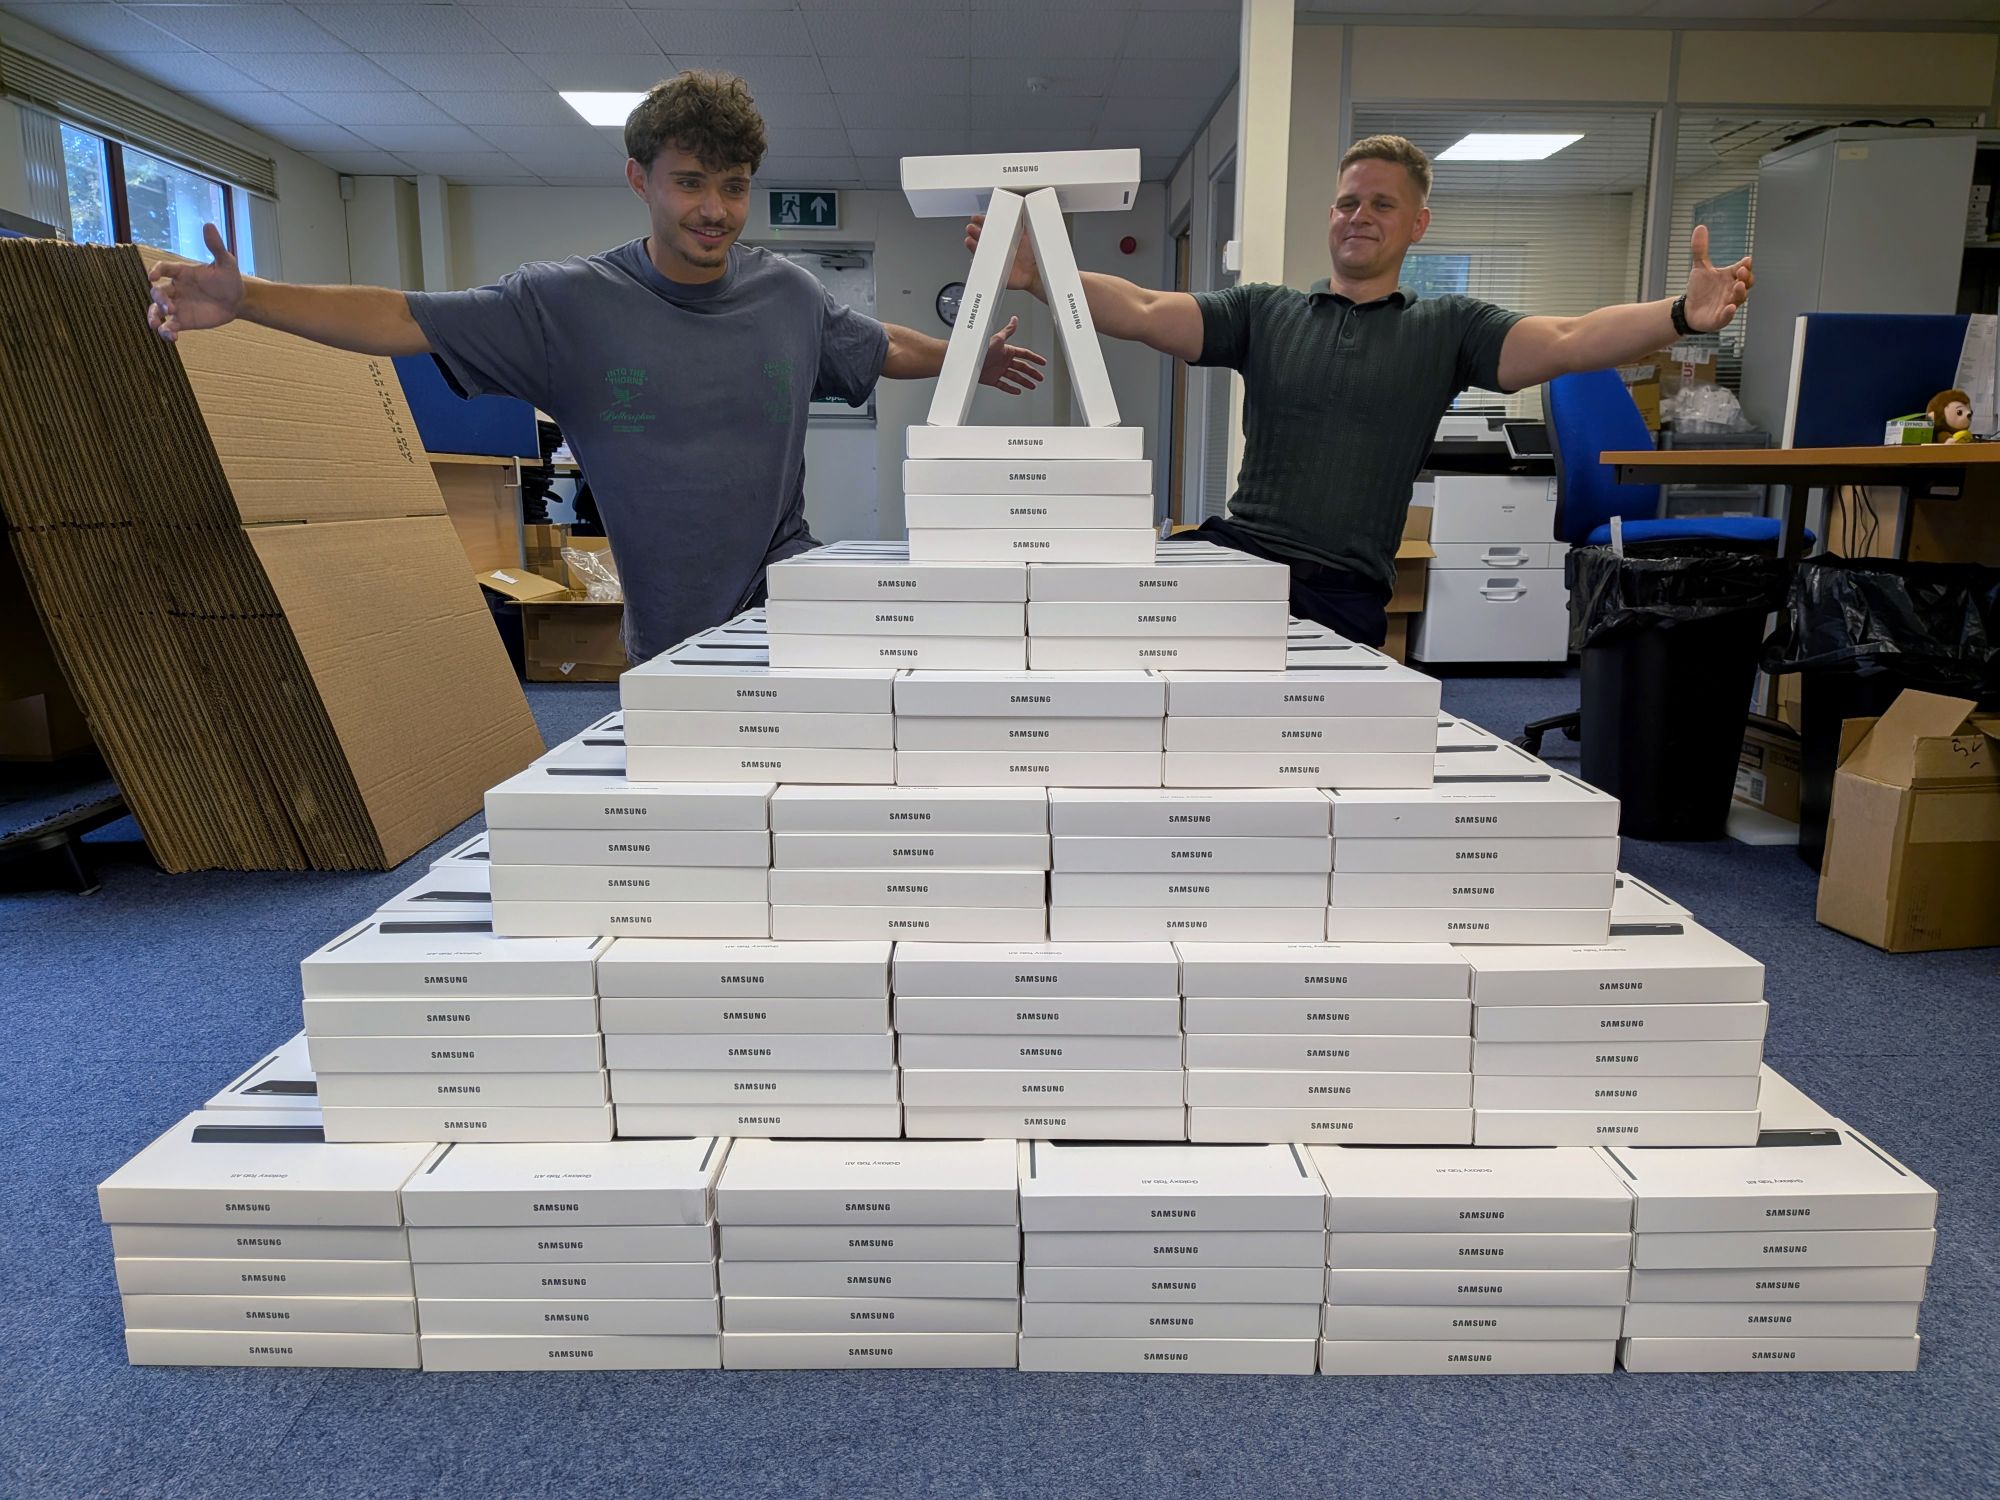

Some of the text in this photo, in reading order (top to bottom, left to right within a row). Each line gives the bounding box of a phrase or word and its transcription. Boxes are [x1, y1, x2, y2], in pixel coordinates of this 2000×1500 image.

[1002, 164, 1039, 173] SAMSUNG
[967, 292, 983, 330] SAMSUNG
[1066, 292, 1083, 330] SAMSUNG
[1007, 438, 1044, 446] SAMSUNG
[1008, 473, 1047, 481] SAMSUNG
[1009, 507, 1048, 516] SAMSUNG
[1012, 541, 1051, 549] SAMSUNG
[877, 578, 917, 588] SAMSUNG
[1138, 579, 1179, 588] SAMSUNG
[875, 614, 915, 623] SAMSUNG
[1137, 615, 1177, 623] SAMSUNG
[879, 648, 919, 657] SAMSUNG
[1138, 649, 1178, 657] SAMSUNG
[736, 689, 778, 698] SAMSUNG
[1010, 695, 1052, 703] SAMSUNG
[1283, 694, 1325, 703] SAMSUNG
[738, 725, 780, 734] SAMSUNG
[1008, 730, 1050, 738] SAMSUNG
[1281, 730, 1323, 739] SAMSUNG
[740, 760, 782, 769] SAMSUNG
[1009, 765, 1050, 773] SAMSUNG
[1278, 766, 1320, 774] SAMSUNG
[604, 807, 648, 816] SAMSUNG
[889, 812, 932, 821] SAMSUNG
[1168, 815, 1211, 823] SAMSUNG
[1454, 815, 1498, 824] SAMSUNG
[608, 844, 651, 852] SAMSUNG
[892, 848, 935, 857] SAMSUNG
[1170, 850, 1213, 859] SAMSUNG
[1455, 851, 1499, 860] SAMSUNG
[607, 879, 651, 887] SAMSUNG
[886, 884, 929, 893] SAMSUNG
[1168, 885, 1210, 894] SAMSUNG
[1452, 887, 1495, 895] SAMSUNG
[609, 916, 652, 924] SAMSUNG
[888, 920, 930, 928] SAMSUNG
[1166, 920, 1208, 929] SAMSUNG
[1447, 922, 1490, 930] SAMSUNG
[423, 975, 468, 984] SAMSUNG
[720, 975, 765, 984] SAMSUNG
[1014, 975, 1058, 983] SAMSUNG
[1304, 975, 1348, 984] SAMSUNG
[1599, 982, 1643, 991] SAMSUNG
[426, 1014, 471, 1023] SAMSUNG
[722, 1012, 767, 1020] SAMSUNG
[1016, 1012, 1060, 1021] SAMSUNG
[1306, 1013, 1350, 1021] SAMSUNG
[1600, 1019, 1644, 1028] SAMSUNG
[431, 1050, 475, 1059] SAMSUNG
[728, 1048, 772, 1057] SAMSUNG
[1019, 1048, 1063, 1056] SAMSUNG
[1306, 1049, 1350, 1058] SAMSUNG
[1595, 1055, 1639, 1063] SAMSUNG
[437, 1085, 481, 1094] SAMSUNG
[733, 1082, 777, 1091] SAMSUNG
[1021, 1084, 1065, 1093] SAMSUNG
[1307, 1086, 1352, 1094] SAMSUNG
[1594, 1089, 1638, 1098] SAMSUNG
[443, 1121, 488, 1129] SAMSUNG
[737, 1116, 781, 1125] SAMSUNG
[1023, 1117, 1067, 1126] SAMSUNG
[1310, 1122, 1354, 1130] SAMSUNG
[1596, 1126, 1639, 1134] SAMSUNG
[225, 1203, 271, 1212] SAMSUNG
[532, 1203, 579, 1212] SAMSUNG
[845, 1203, 891, 1212] SAMSUNG
[1150, 1209, 1197, 1218] SAMSUNG
[1459, 1211, 1505, 1220] SAMSUNG
[1765, 1208, 1811, 1217] SAMSUNG
[236, 1238, 282, 1246] SAMSUNG
[537, 1241, 584, 1250] SAMSUNG
[848, 1239, 894, 1247] SAMSUNG
[1152, 1246, 1199, 1255] SAMSUNG
[1458, 1248, 1505, 1256] SAMSUNG
[1762, 1245, 1808, 1254] SAMSUNG
[241, 1274, 287, 1282] SAMSUNG
[541, 1278, 587, 1286] SAMSUNG
[847, 1276, 892, 1284] SAMSUNG
[1151, 1282, 1197, 1290] SAMSUNG
[1457, 1285, 1503, 1294] SAMSUNG
[1755, 1281, 1801, 1289] SAMSUNG
[245, 1311, 290, 1320] SAMSUNG
[544, 1313, 590, 1322] SAMSUNG
[849, 1311, 895, 1320] SAMSUNG
[1747, 1315, 1792, 1324] SAMSUNG
[1149, 1317, 1194, 1326] SAMSUNG
[1452, 1319, 1497, 1328] SAMSUNG
[248, 1346, 293, 1355] SAMSUNG
[548, 1350, 594, 1358] SAMSUNG
[848, 1348, 894, 1356] SAMSUNG
[1751, 1351, 1796, 1359] SAMSUNG
[1143, 1352, 1189, 1361] SAMSUNG
[1447, 1354, 1492, 1362] SAMSUNG
